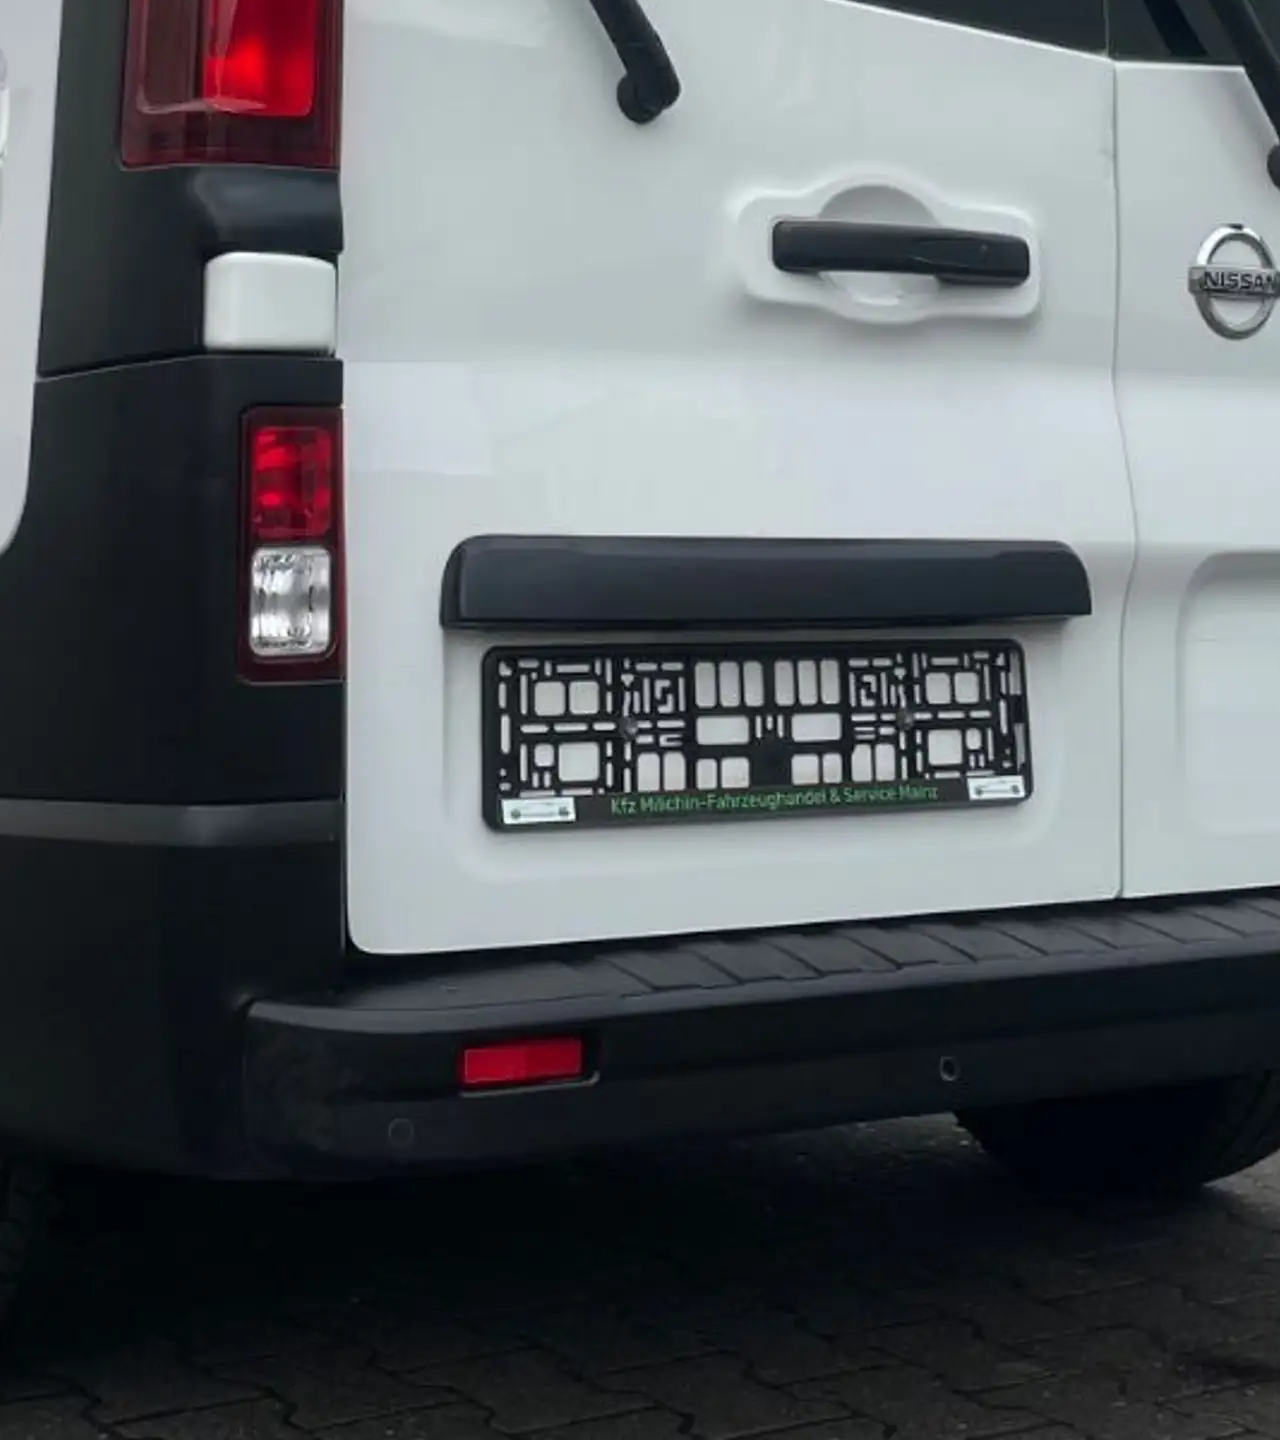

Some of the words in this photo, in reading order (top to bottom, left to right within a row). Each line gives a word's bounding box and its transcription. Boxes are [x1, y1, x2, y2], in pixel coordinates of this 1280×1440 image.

[1202, 271, 1279, 292] NISSAN
[610, 796, 637, 816] Kfz
[829, 787, 841, 804] &
[844, 785, 897, 803] Service
